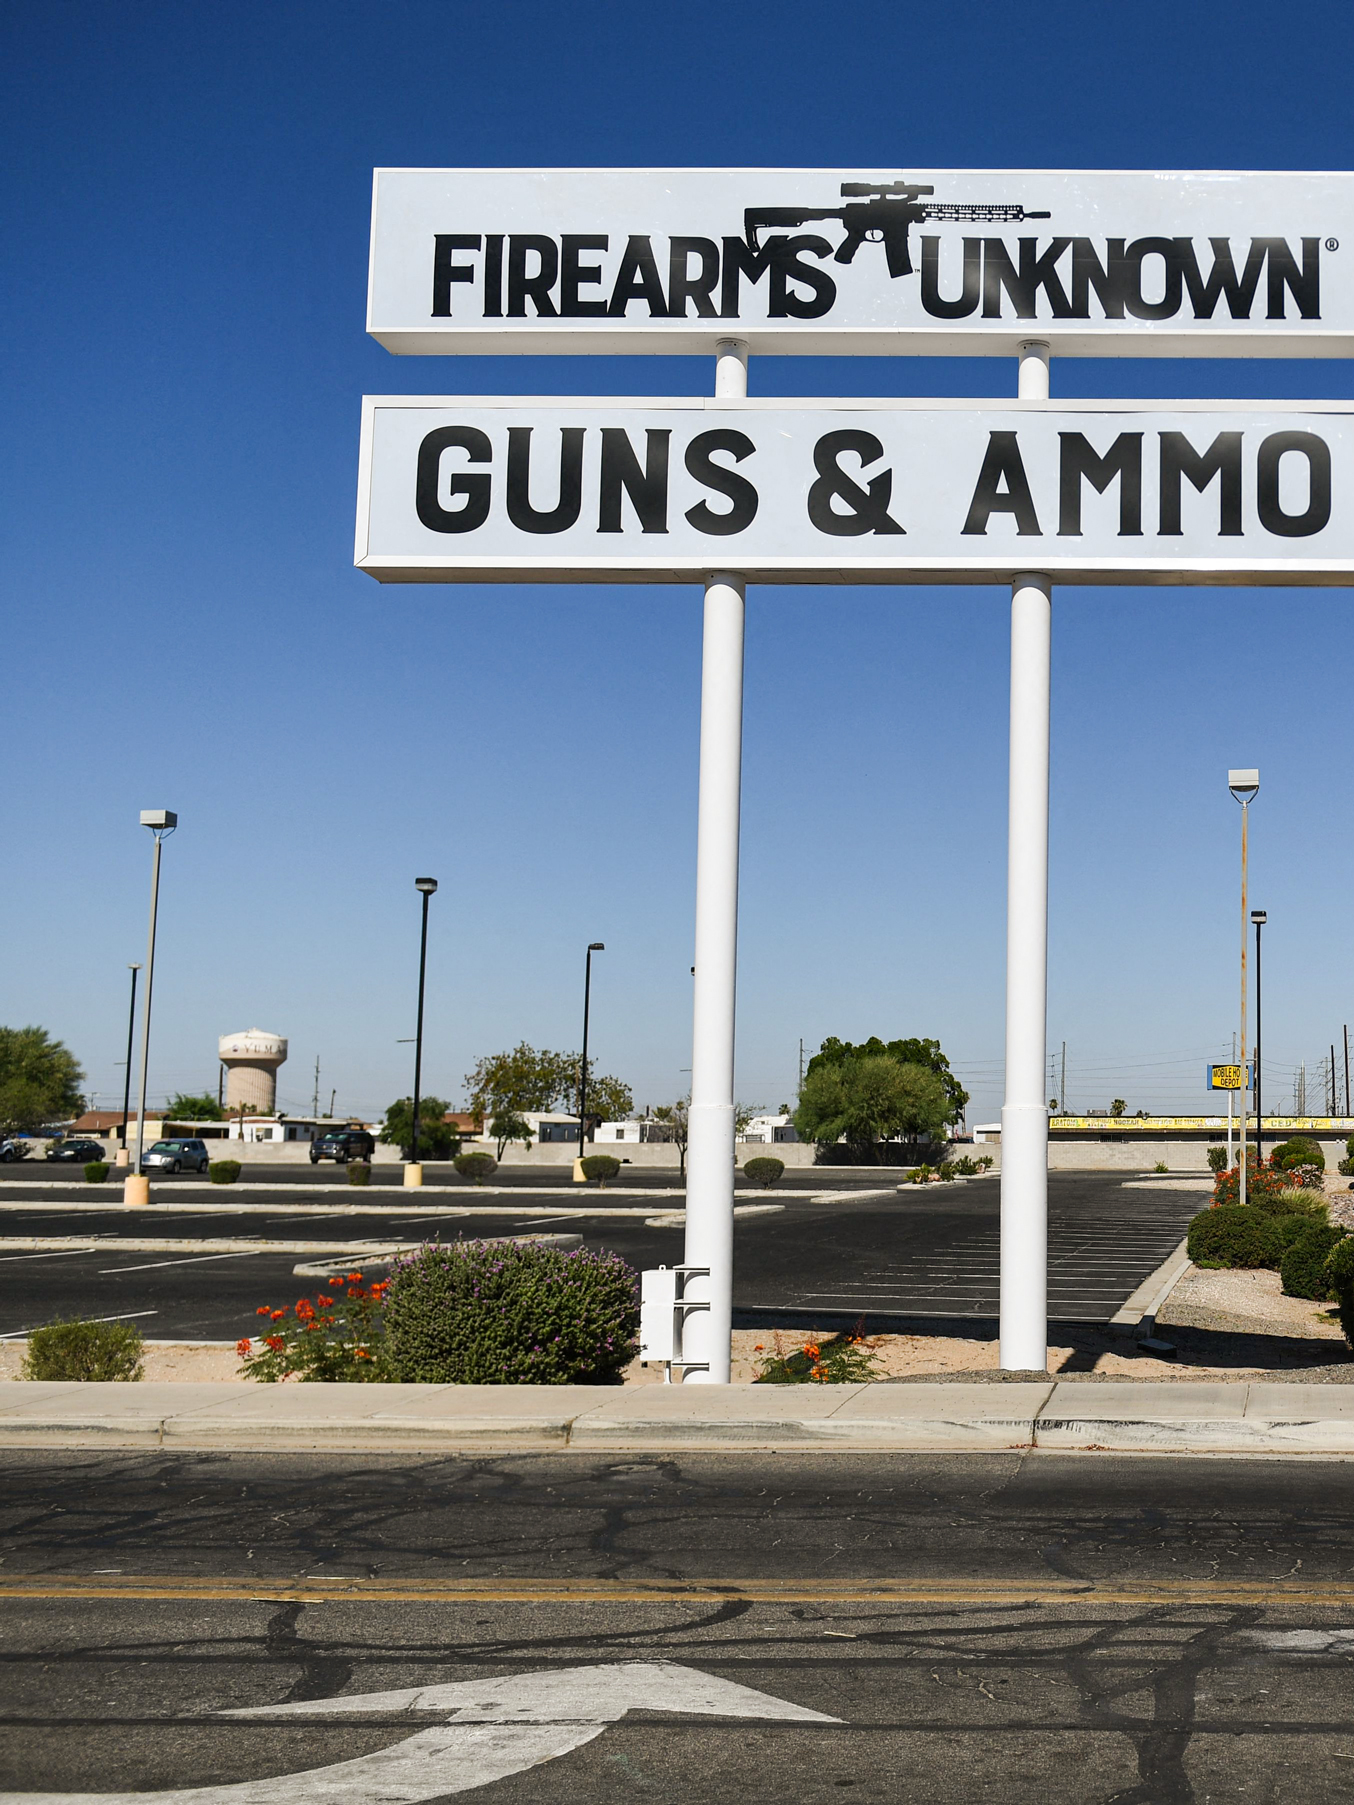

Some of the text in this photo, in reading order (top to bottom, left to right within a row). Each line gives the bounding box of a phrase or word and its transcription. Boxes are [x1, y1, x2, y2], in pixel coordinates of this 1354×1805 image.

[430, 233, 836, 318] FIREARMS
[414, 424, 1332, 539] GUNS & AMMO
[245, 1044, 282, 1055] YUMA
[1213, 1066, 1248, 1079] MOBILE HOE
[1220, 1078, 1240, 1087] DEPOT
